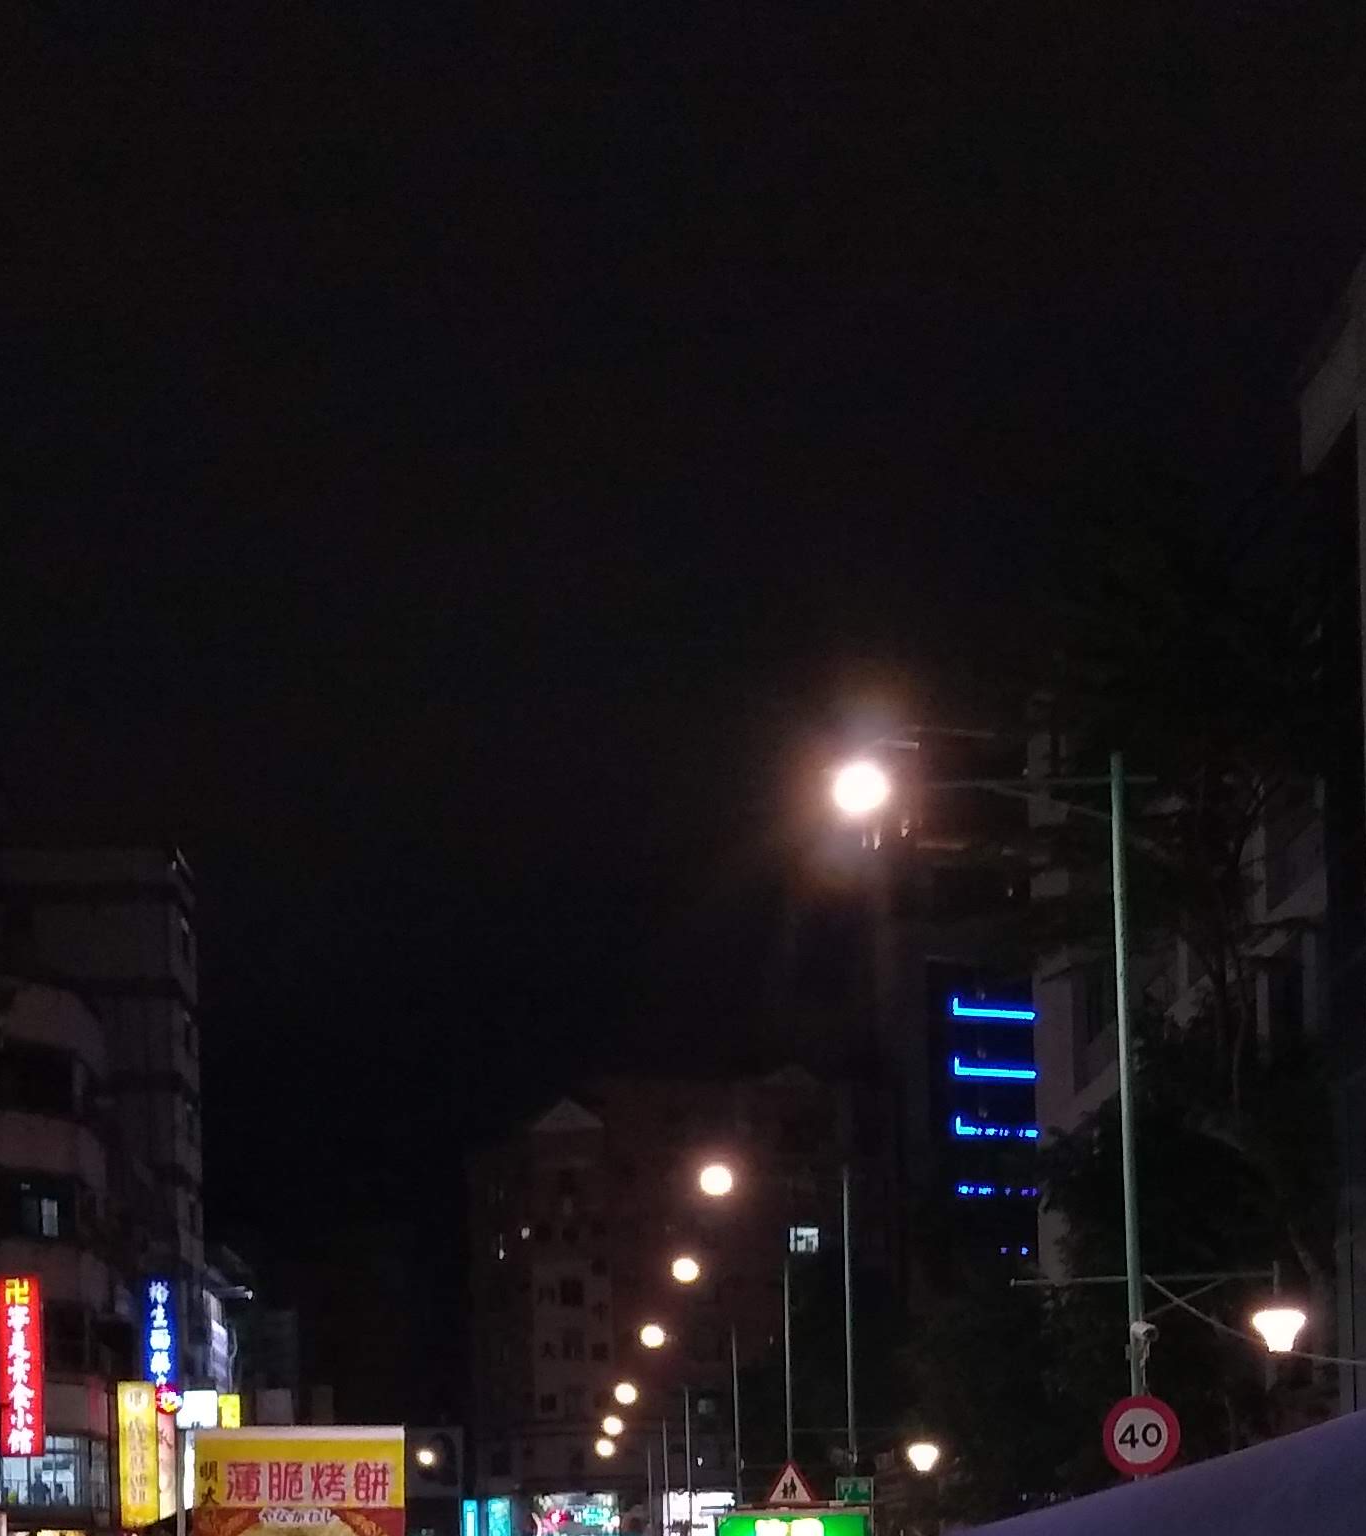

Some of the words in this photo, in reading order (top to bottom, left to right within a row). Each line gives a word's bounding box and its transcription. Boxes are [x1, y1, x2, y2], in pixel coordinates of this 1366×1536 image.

[1118, 1422, 1163, 1449] 40
[226, 1461, 390, 1503] 薄脆烤餅
